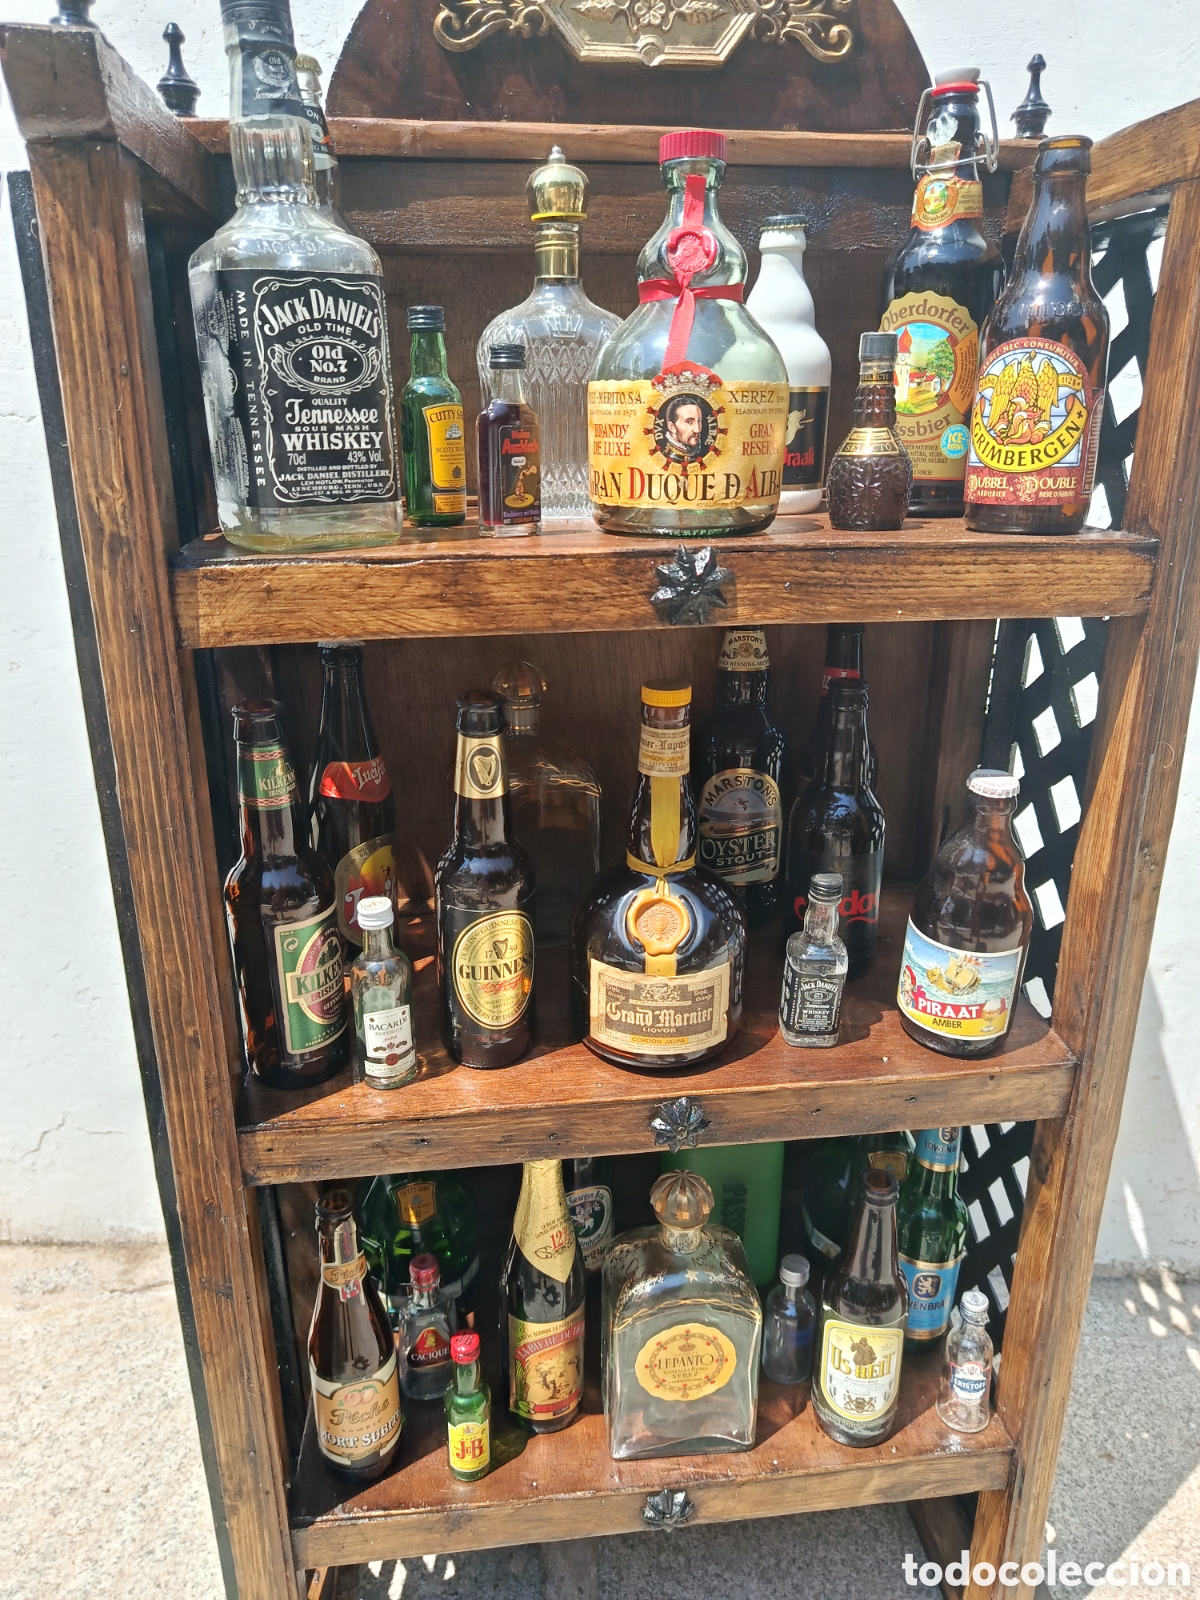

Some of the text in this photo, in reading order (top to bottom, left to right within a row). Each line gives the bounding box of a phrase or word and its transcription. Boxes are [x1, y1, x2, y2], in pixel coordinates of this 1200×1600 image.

[260, 297, 311, 336] JACK
[309, 288, 381, 338] DANIEL'S
[882, 299, 970, 335] Oberdorfer
[297, 323, 353, 336] OLD TIME
[311, 345, 343, 359] Old
[1003, 341, 1020, 352] NEC
[1023, 340, 1080, 368] CONSUMITUR
[309, 359, 348, 373] No.7
[313, 376, 346, 384] BRAND
[1061, 375, 1078, 386] 1128
[235, 290, 266, 487] MADE IN TENNESSEE
[311, 398, 348, 406] QUALITY
[728, 390, 775, 405] XEREZ
[285, 398, 379, 425] Tennessee
[429, 410, 455, 423] CUTTY
[594, 423, 630, 439] BRANDY
[655, 417, 665, 440] DVX
[749, 423, 776, 439] GRAN
[280, 431, 384, 451] WHISKEY
[593, 441, 631, 457] DE LUXE
[974, 420, 1082, 467] GRIMBERGEN
[287, 450, 384, 466] 70cl 43% Vol.
[279, 473, 305, 481] JACK
[307, 472, 340, 480] DANIEL
[590, 463, 623, 499] GRAN
[627, 466, 716, 505] DUQUE
[1021, 474, 1078, 492] DOUBLE
[728, 635, 763, 646] MARSTON'S
[268, 788, 286, 797] IRISH
[705, 775, 777, 808] MARSTON'S
[701, 830, 776, 859] OYSTER
[716, 851, 765, 866] STOUT
[485, 943, 518, 959] 17 59
[310, 983, 334, 1002] IRISH
[800, 981, 816, 991] JACK
[606, 1001, 713, 1028] Grand Marnier
[917, 996, 980, 1019] PIRAAT
[368, 1016, 408, 1031] BACARDI
[491, 1014, 500, 1022] OF
[931, 1017, 963, 1029] AMBER
[631, 1036, 662, 1045] CORDON
[665, 1037, 687, 1045] JAUNE
[658, 1353, 714, 1370] LEPANTO
[953, 1378, 987, 1390] ERISTOFF
[455, 1437, 484, 1460] J&B
